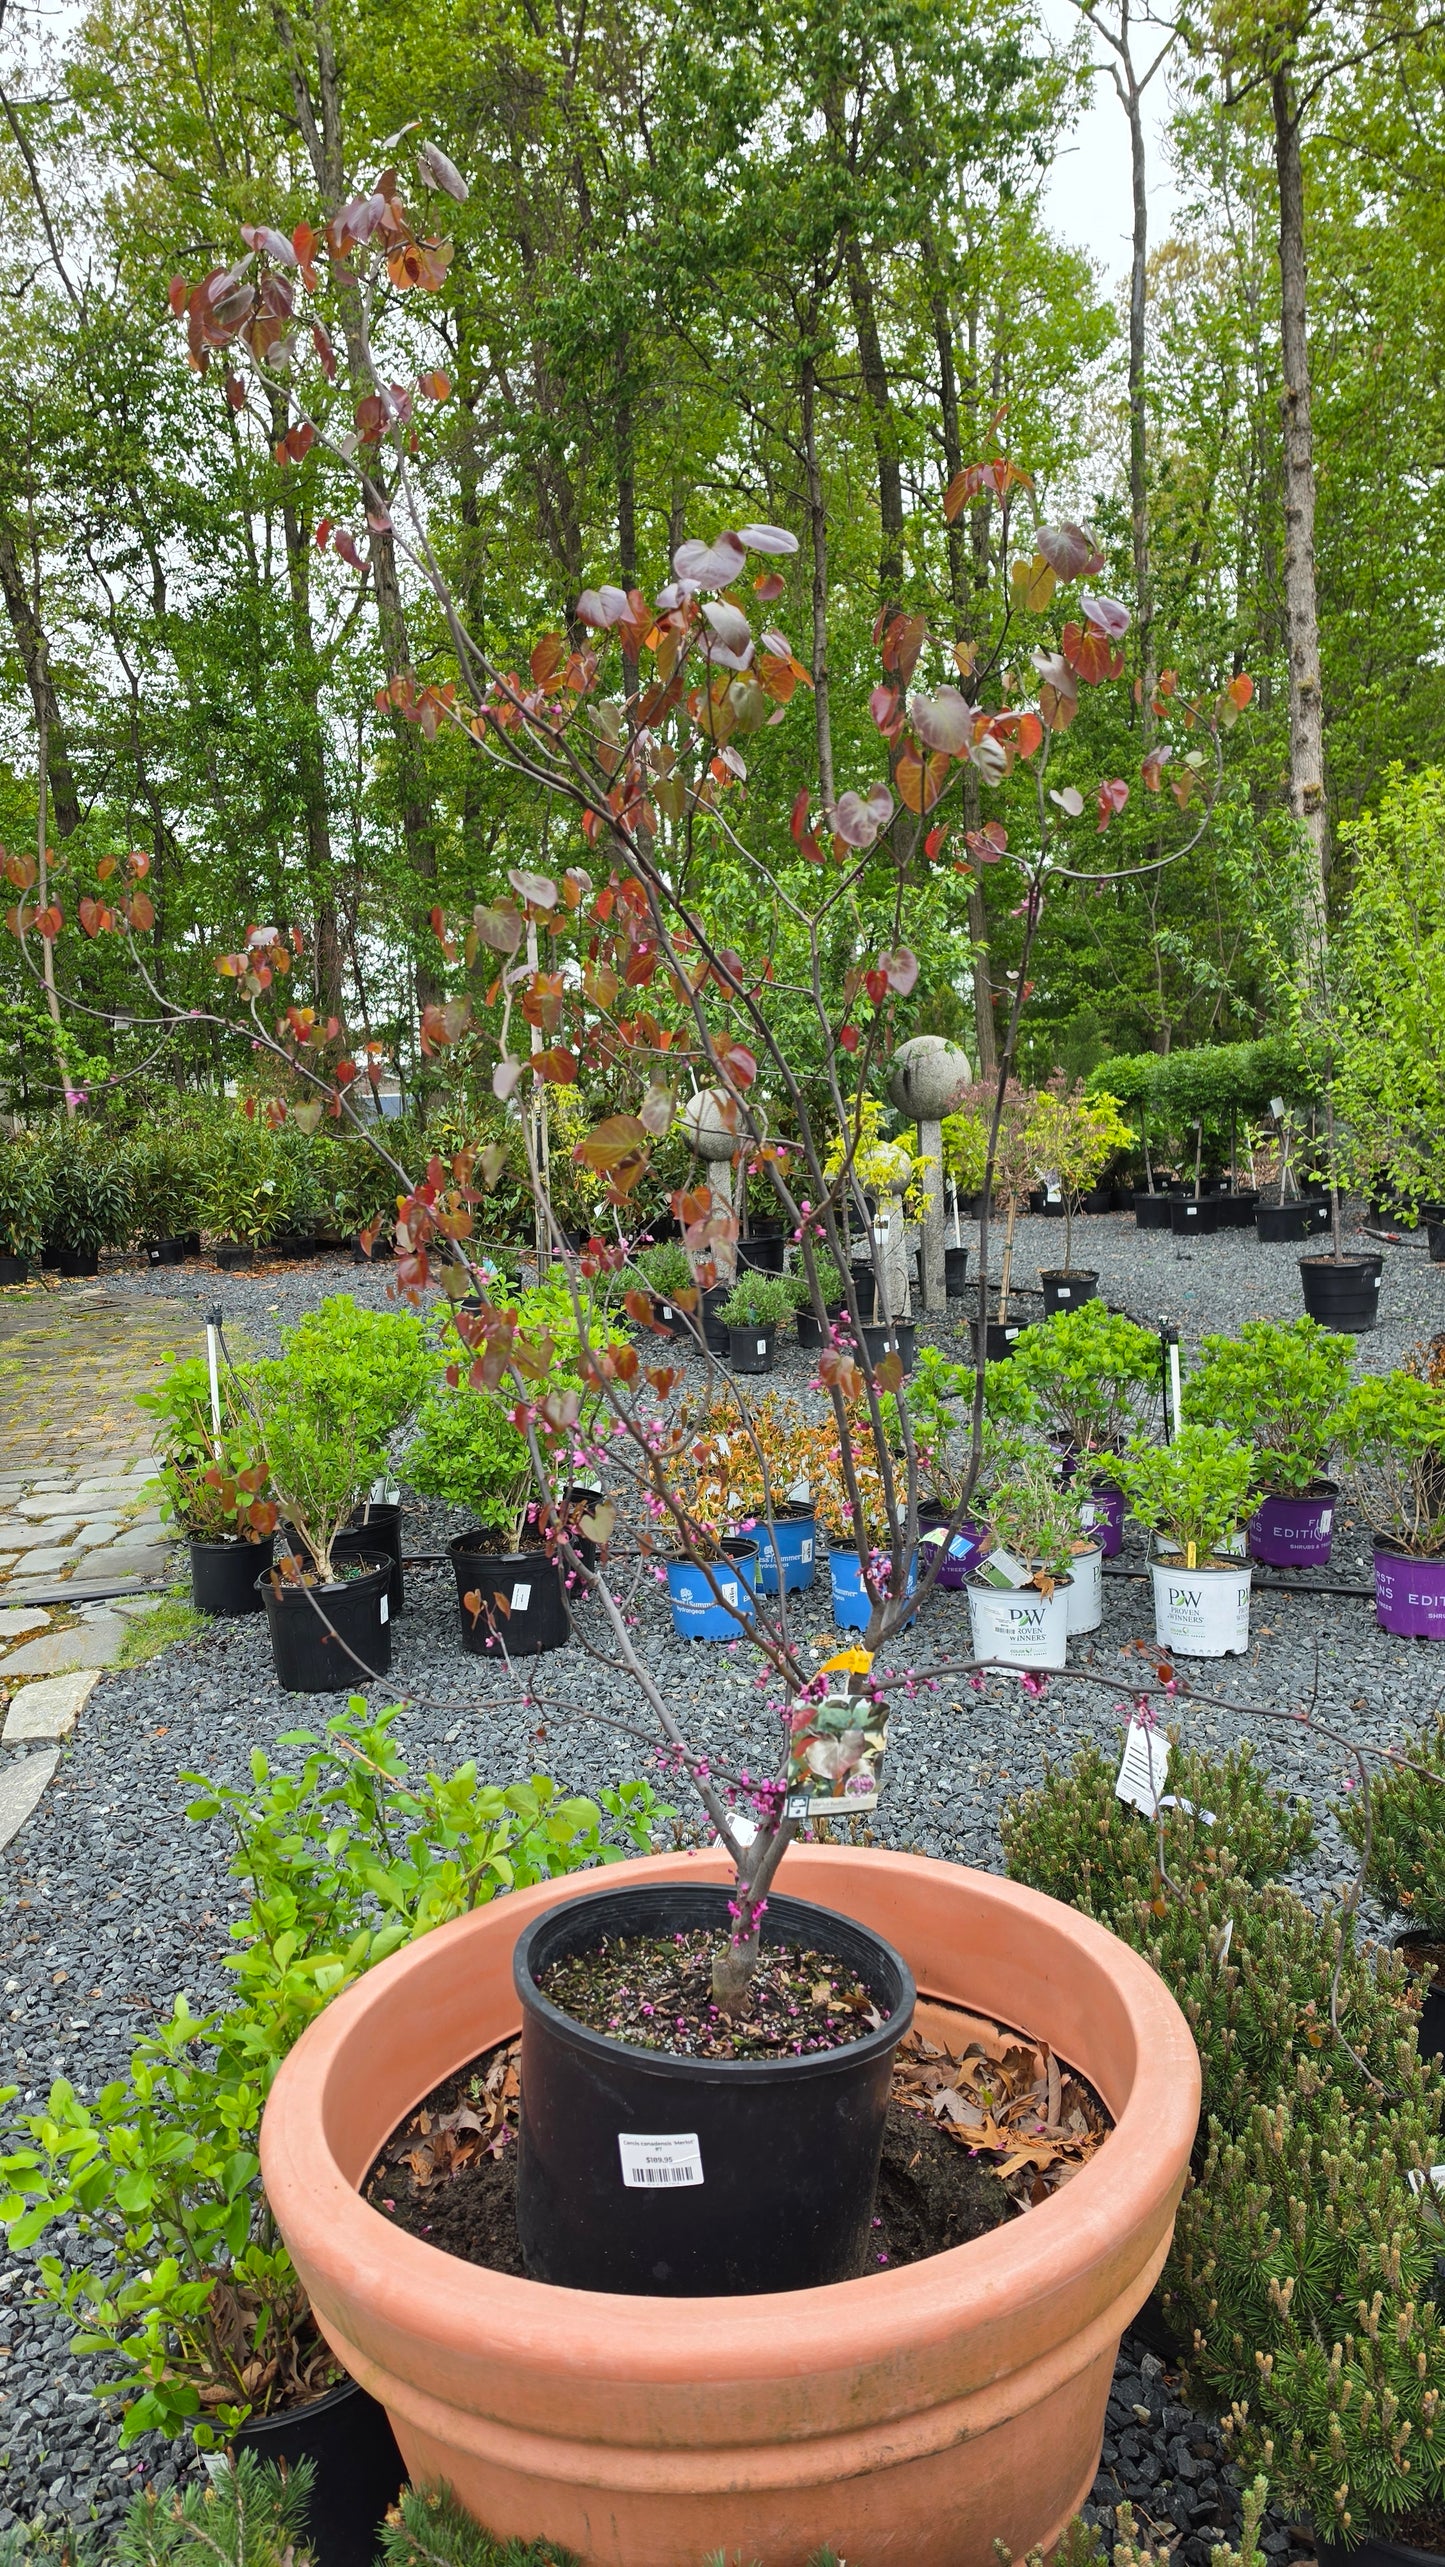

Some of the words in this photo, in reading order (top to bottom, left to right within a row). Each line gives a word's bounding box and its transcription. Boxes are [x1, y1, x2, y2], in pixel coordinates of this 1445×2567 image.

[1273, 1527, 1332, 1541] EDITIO
[1168, 1588, 1202, 1608] PW
[1008, 1608, 1046, 1627] PW
[1171, 1606, 1200, 1616] PROVEN
